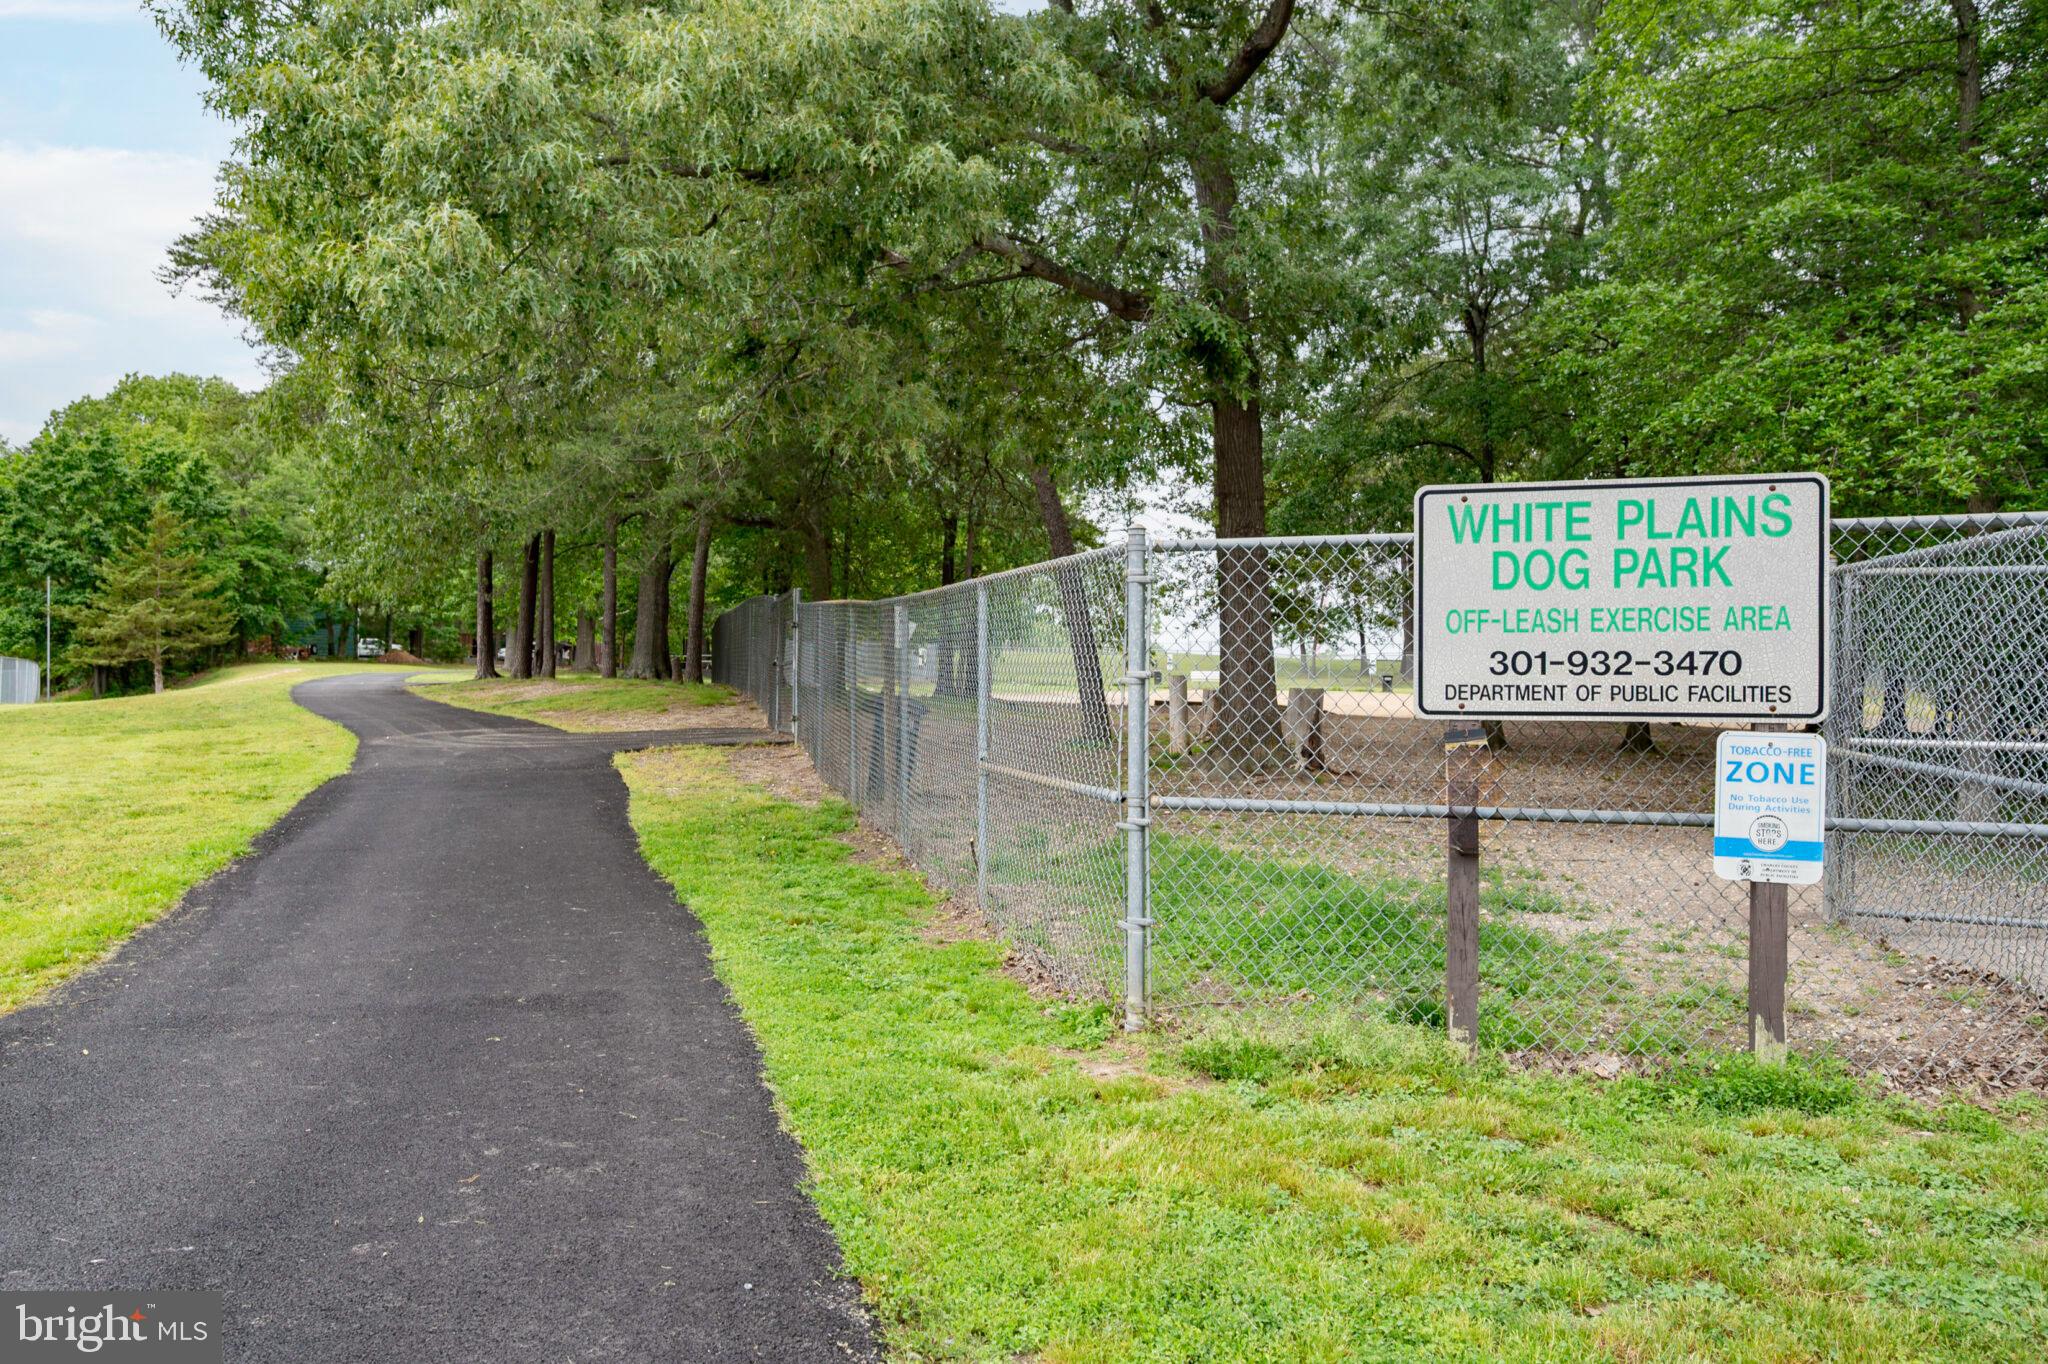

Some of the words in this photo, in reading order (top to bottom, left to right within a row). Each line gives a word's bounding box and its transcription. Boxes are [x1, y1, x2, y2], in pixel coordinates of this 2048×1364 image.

[1447, 501, 1593, 544] WHITE
[1616, 493, 1793, 541] PLAINS
[1491, 548, 1590, 591] DOG
[1613, 544, 1734, 590] PARK
[1445, 607, 1579, 635] OFF-LEASH
[1590, 606, 1712, 633] EXERCISE
[1723, 605, 1792, 632] AREA
[1489, 650, 1742, 676] 301-932-3470
[1445, 684, 1568, 702] DEPARTMENT
[1575, 684, 1602, 702] OF
[1610, 684, 1679, 703] PUBLIC
[1688, 685, 1792, 703] FACILITIES
[1730, 745, 1813, 758] TOBACCO-FREE
[1726, 760, 1816, 785] ZONE
[1728, 802, 1761, 813] During
[1765, 804, 1811, 814] Activities
[1730, 793, 1744, 802] No
[1748, 794, 1788, 803] Tobacco
[1792, 796, 1809, 804] Use
[1757, 837, 1777, 846] HERE
